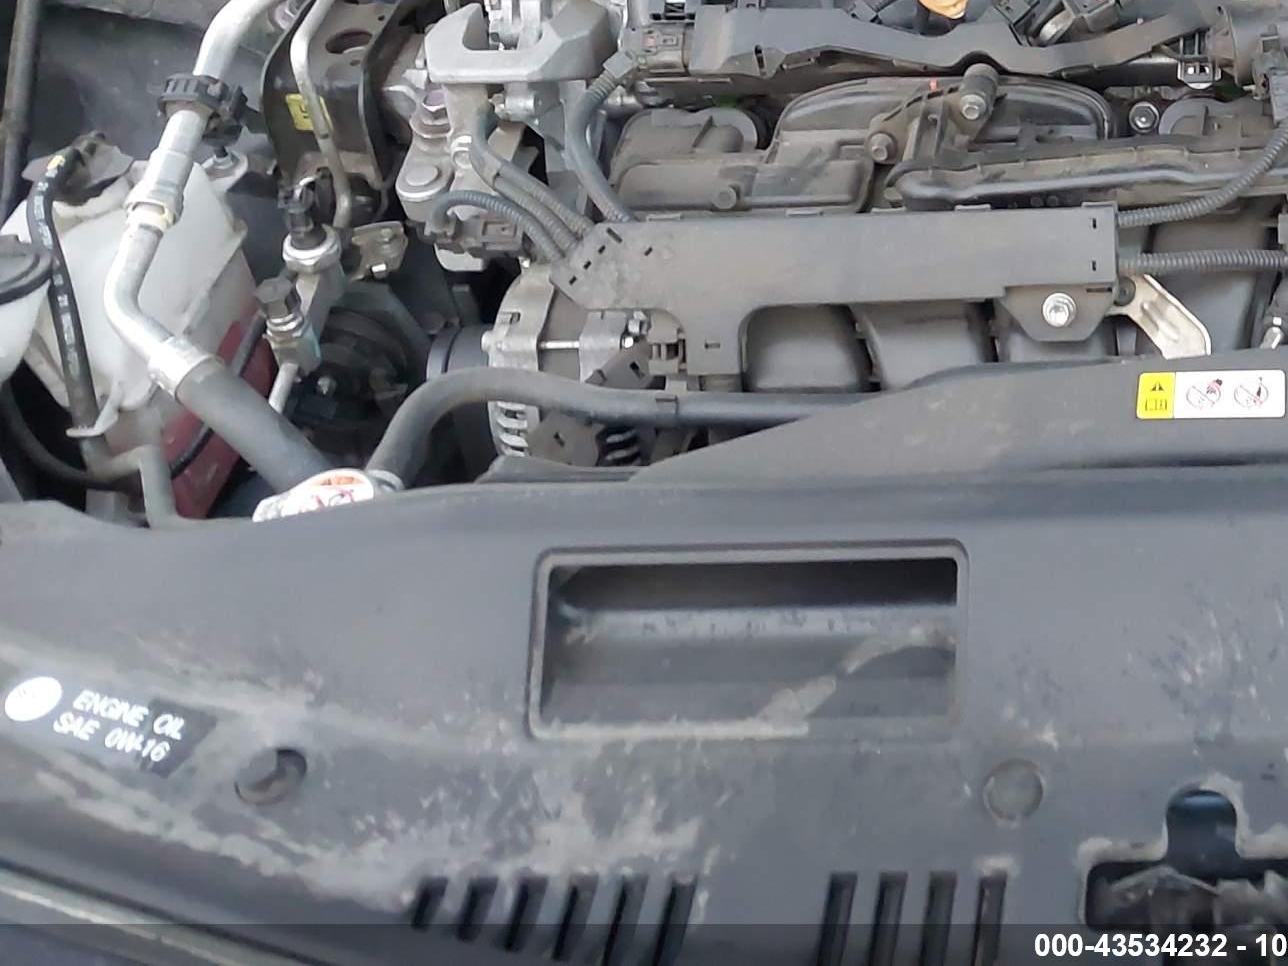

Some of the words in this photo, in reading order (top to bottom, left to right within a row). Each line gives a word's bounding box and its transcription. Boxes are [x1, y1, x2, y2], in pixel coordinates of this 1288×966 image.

[53, 712, 100, 741] SAE
[104, 727, 170, 762] 0W-16
[73, 689, 149, 727] ENGINE
[153, 714, 185, 740] OIL
